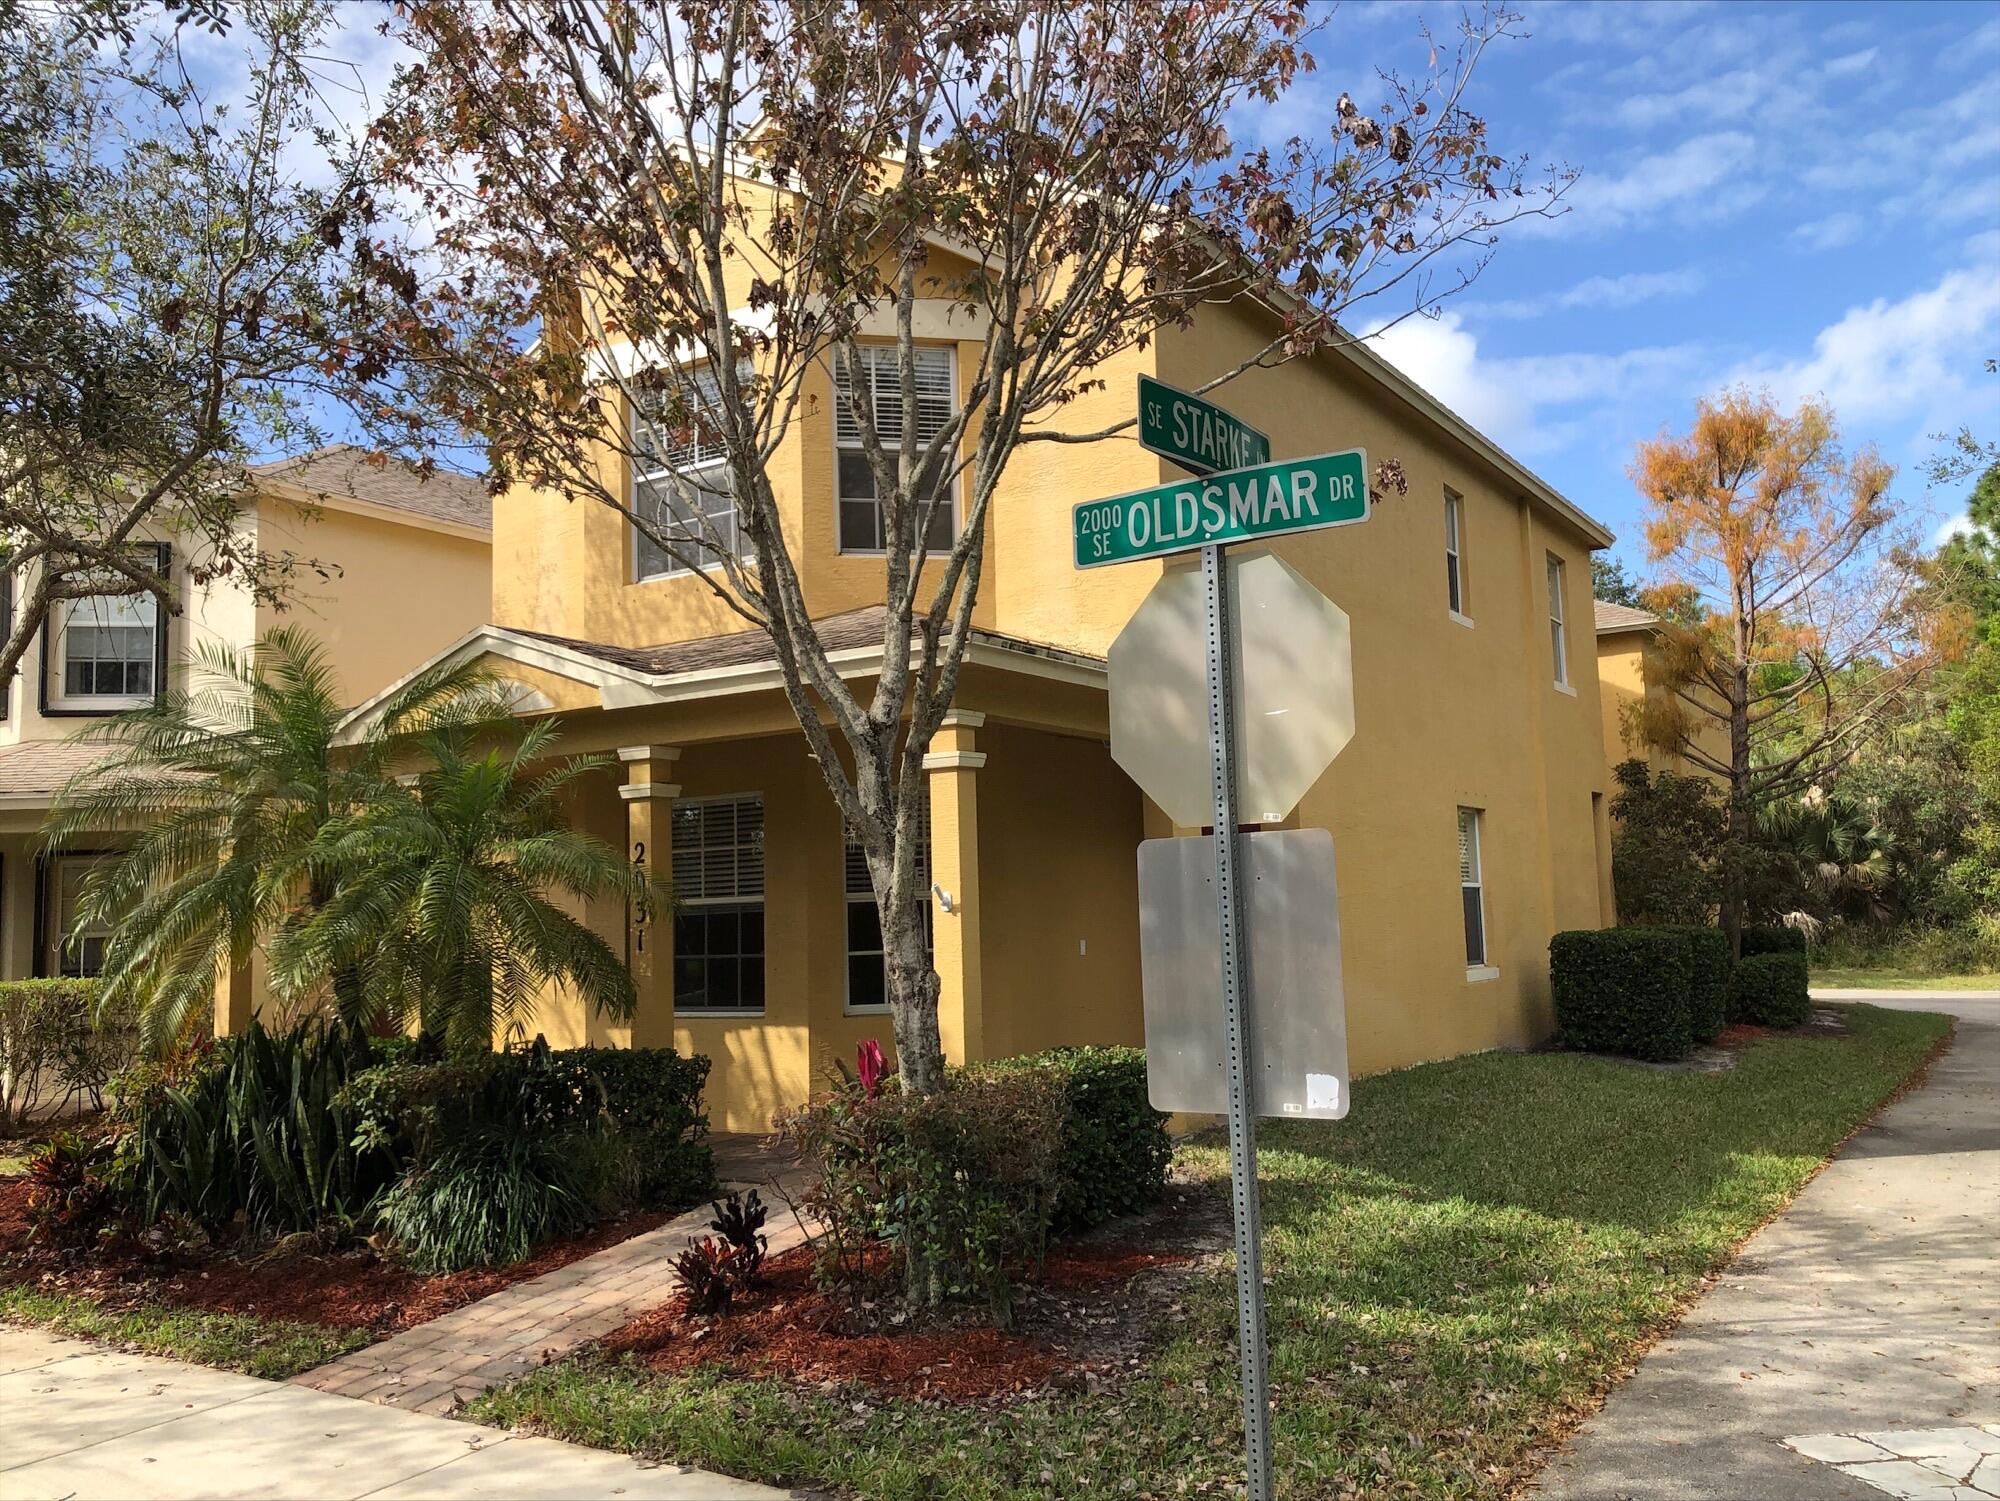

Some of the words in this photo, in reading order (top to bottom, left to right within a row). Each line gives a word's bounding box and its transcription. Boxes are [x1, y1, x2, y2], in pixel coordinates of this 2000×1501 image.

[1148, 402, 1162, 430] SE
[1172, 401, 1250, 468] STARKE
[1081, 505, 1121, 535] 2000
[1093, 533, 1111, 557] SE
[1128, 470, 1320, 548] OLDSMAR
[1329, 474, 1354, 502] DR
